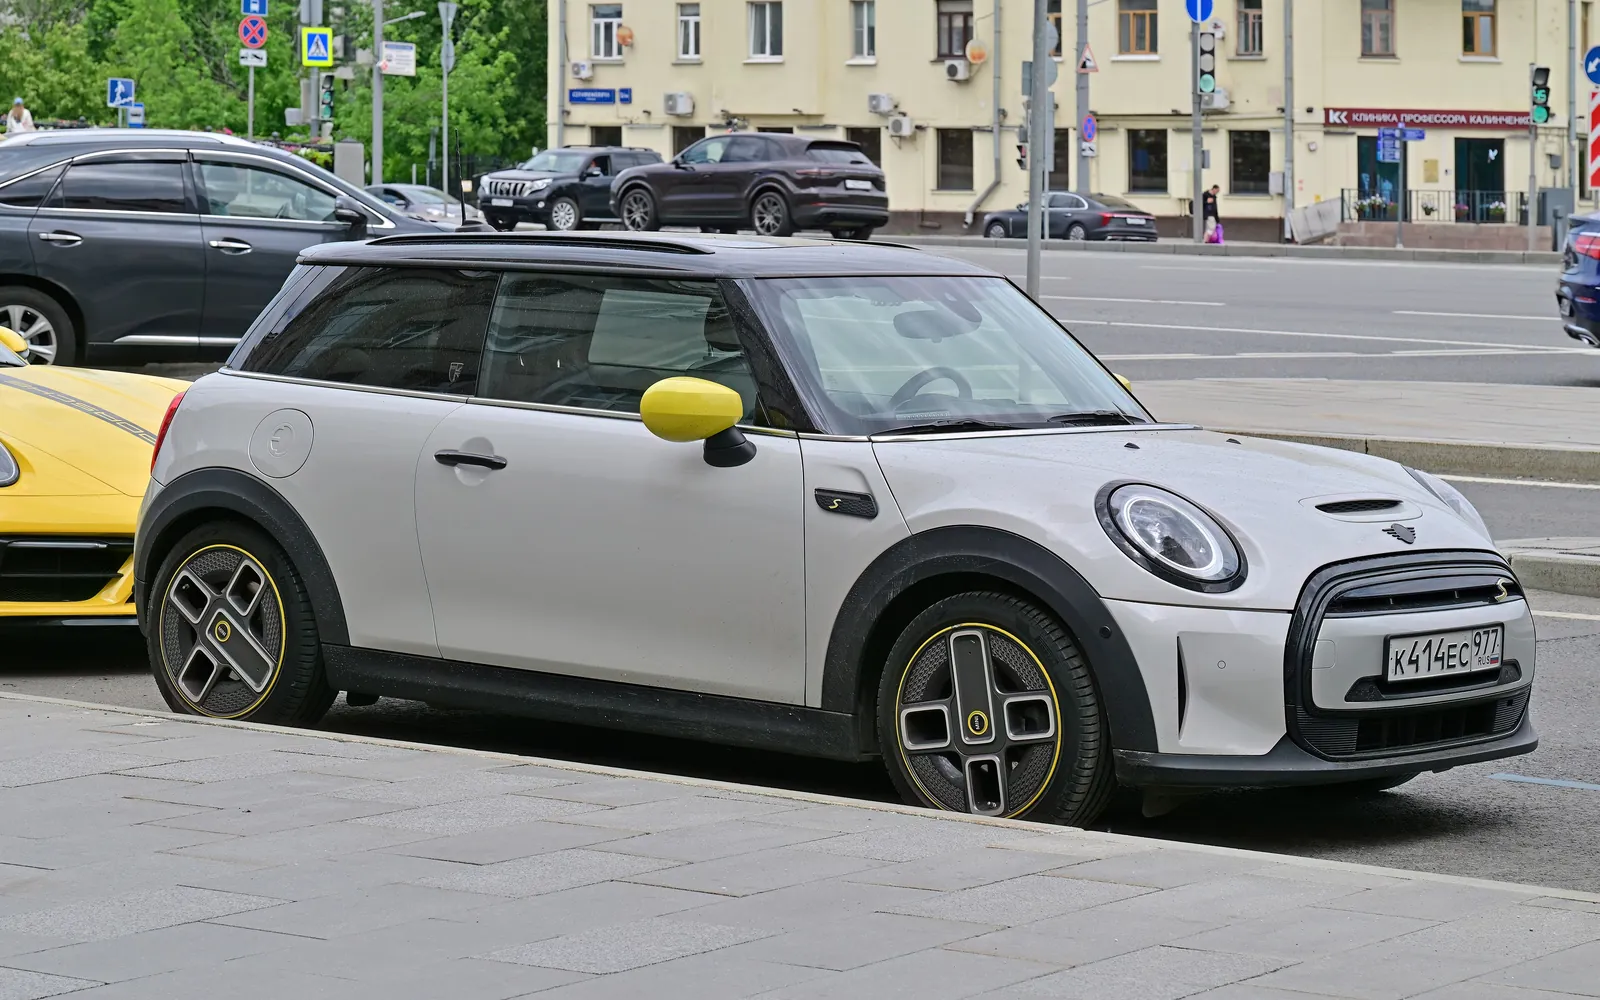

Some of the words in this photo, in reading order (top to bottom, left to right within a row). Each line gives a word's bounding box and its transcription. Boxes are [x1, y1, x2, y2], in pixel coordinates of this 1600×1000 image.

[1352, 112, 1398, 122] КЛИНИКА
[1400, 113, 1467, 124] ПРОФЕССОРА
[828, 498, 842, 509] S
[1494, 578, 1514, 602] S
[1473, 628, 1499, 657] 977
[1477, 655, 1490, 666] RUS
